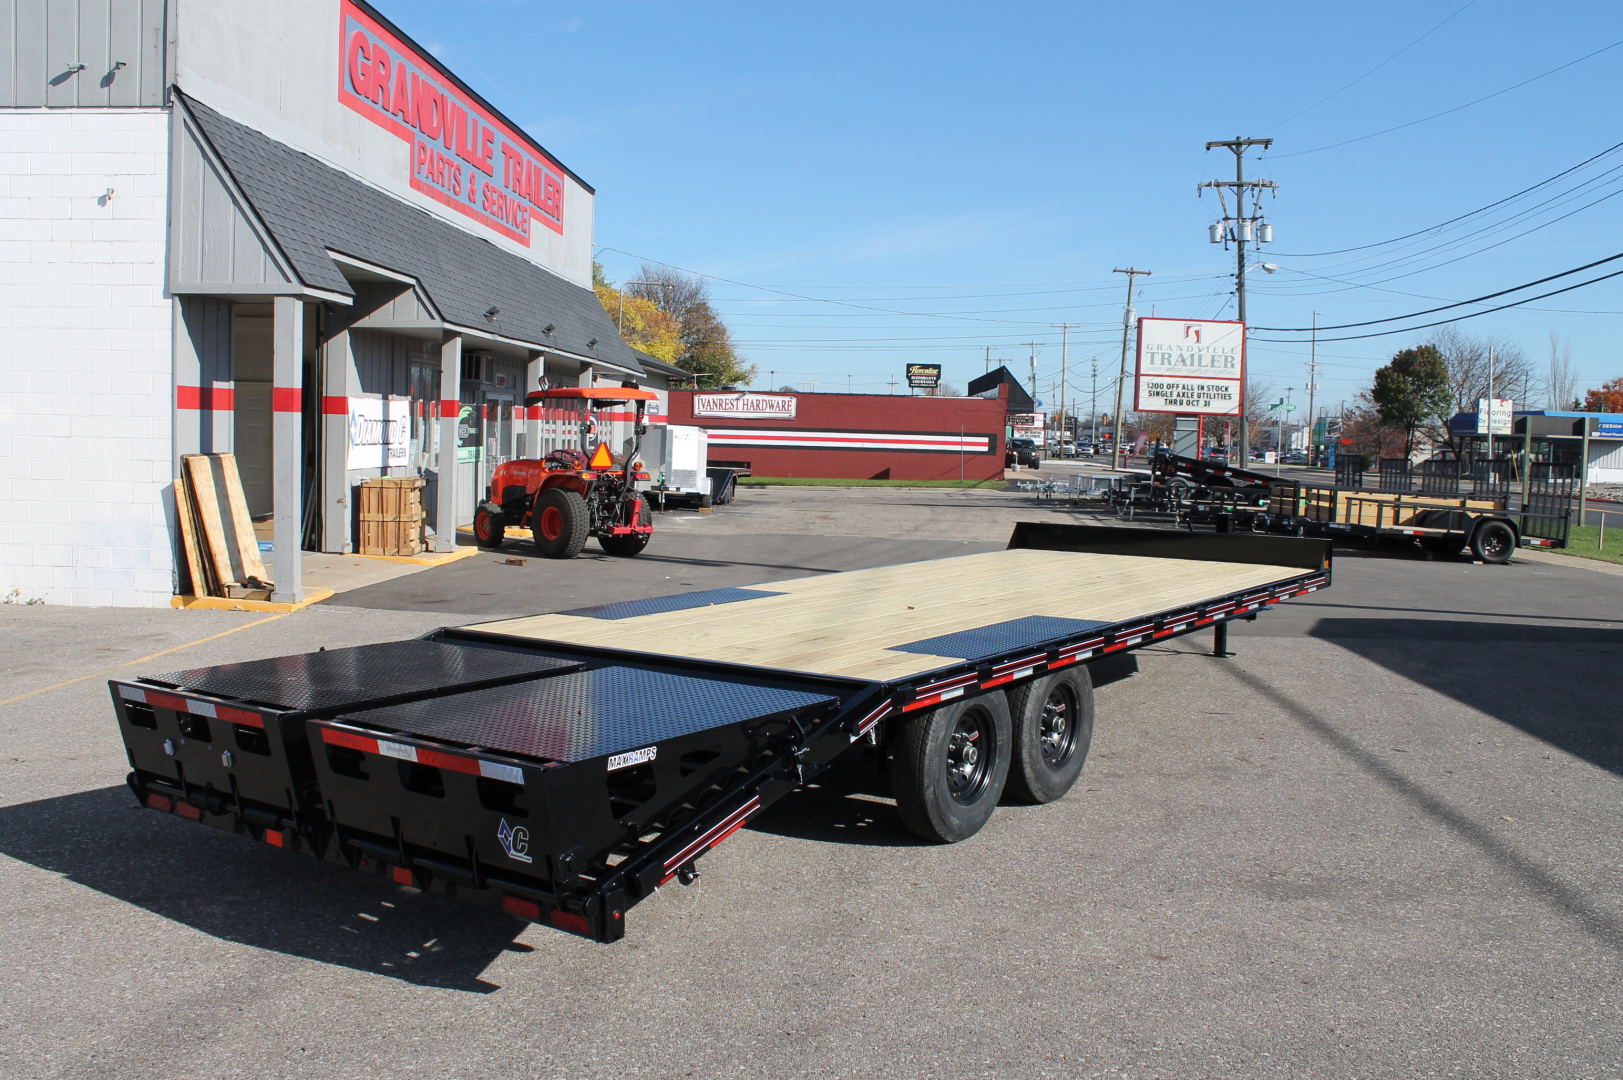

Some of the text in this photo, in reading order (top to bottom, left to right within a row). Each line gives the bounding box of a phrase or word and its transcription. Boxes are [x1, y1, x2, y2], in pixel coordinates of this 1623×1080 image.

[348, 30, 562, 222] GRANDVILLE TRAILER
[417, 140, 528, 233] PARTS & SERVICE
[1146, 343, 1237, 355] GRANDVILLE
[1145, 351, 1236, 369] TRAILER
[1148, 390, 1232, 400] SINGLE AXLE UTILITIES
[697, 397, 793, 412] IVANREST HARDWARE
[354, 414, 407, 446] DIAMOND C
[387, 448, 407, 458] TRAILERS
